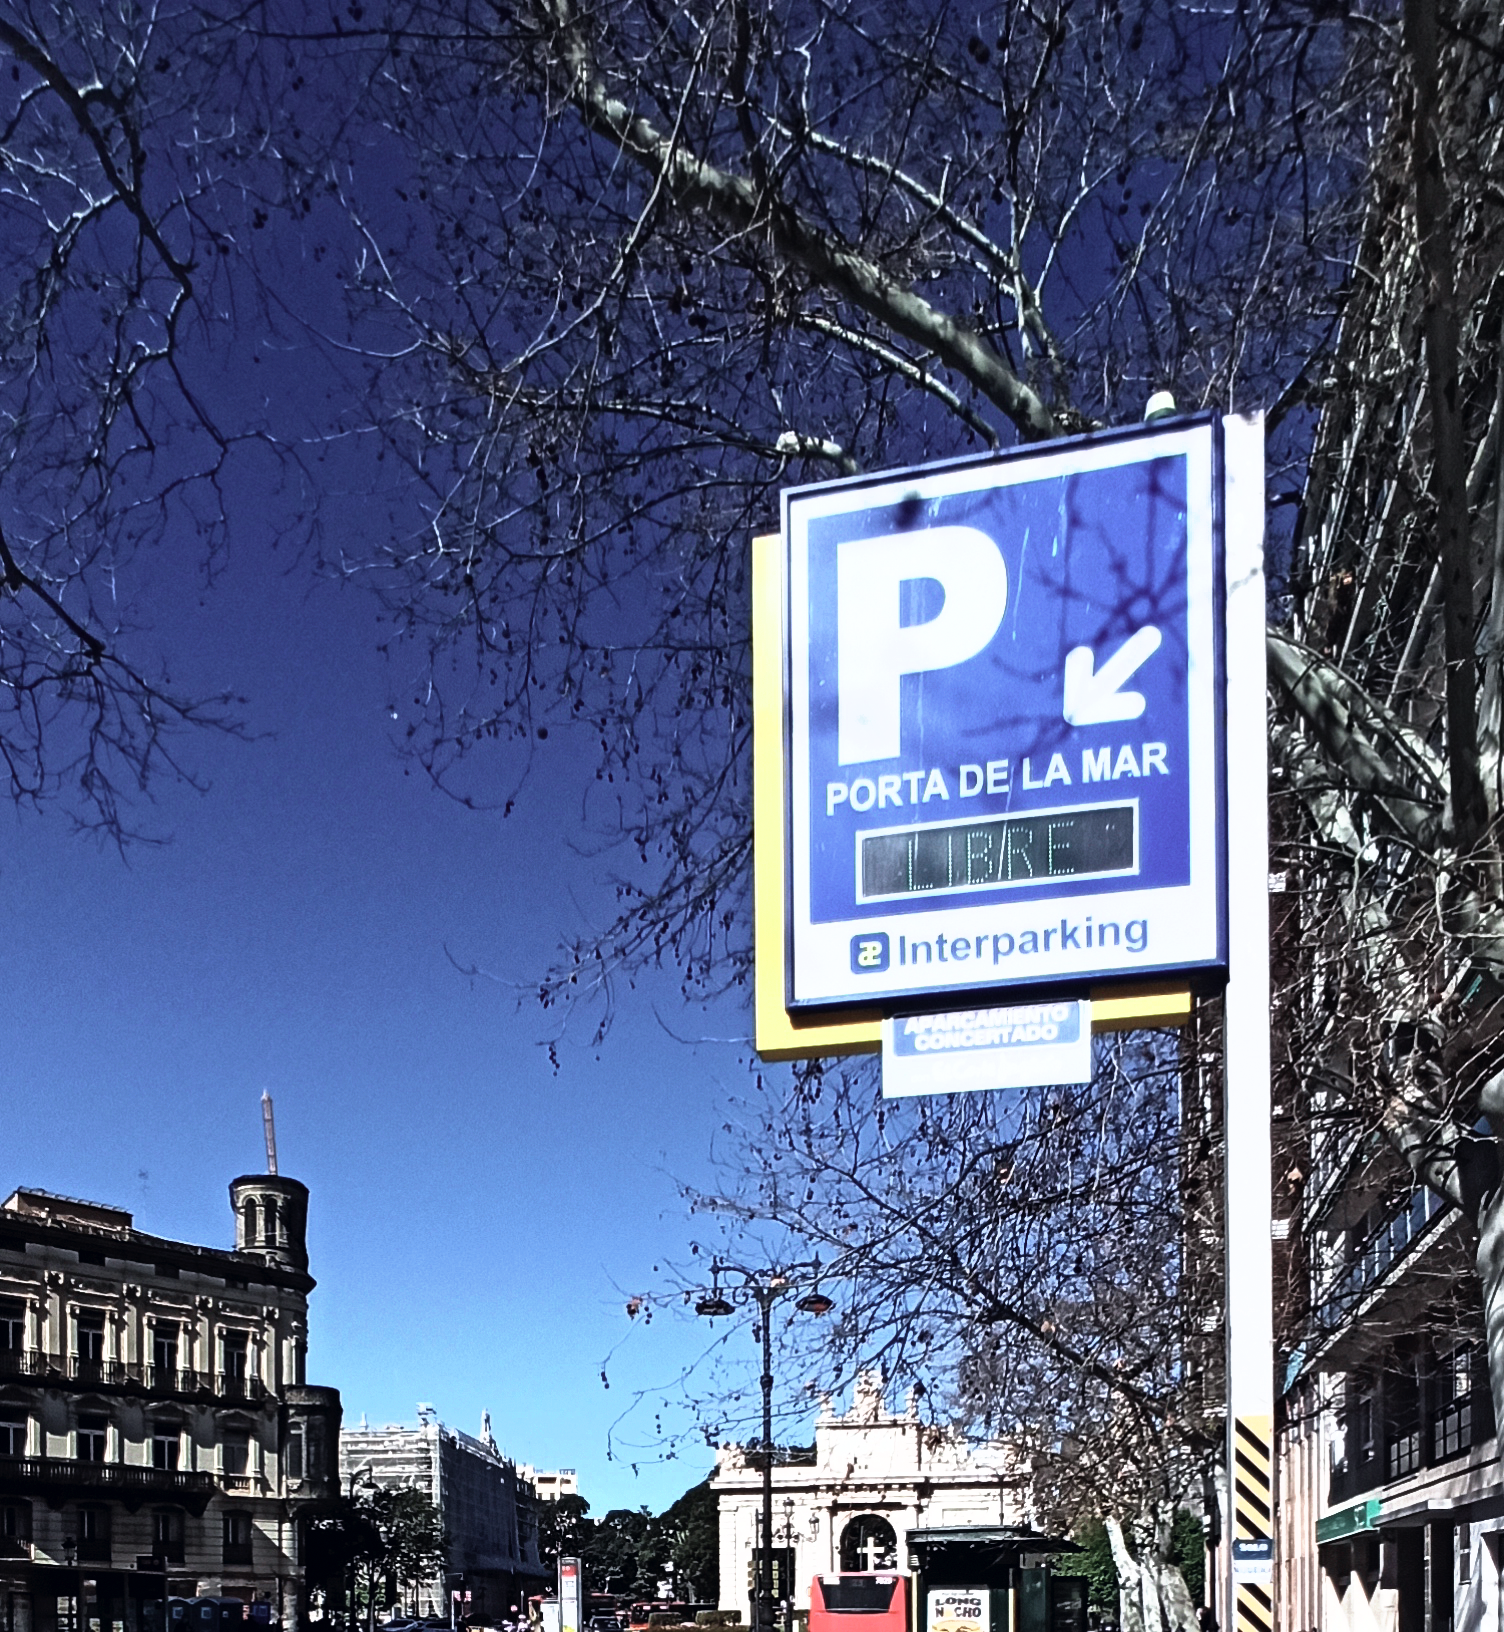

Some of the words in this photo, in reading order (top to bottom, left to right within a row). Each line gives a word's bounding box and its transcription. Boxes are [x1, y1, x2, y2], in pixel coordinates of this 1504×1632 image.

[836, 525, 1009, 766] P
[826, 768, 950, 816] PORTA
[959, 759, 1010, 798] DE
[1021, 753, 1073, 790] LA
[1081, 742, 1170, 784] MAR
[908, 821, 1075, 891] LIBRE
[899, 916, 1149, 966] Interparking
[904, 1002, 1070, 1035] APARCAMIENTO
[914, 1023, 1059, 1052] CONCERTADO
[935, 1597, 982, 1607] LONG
